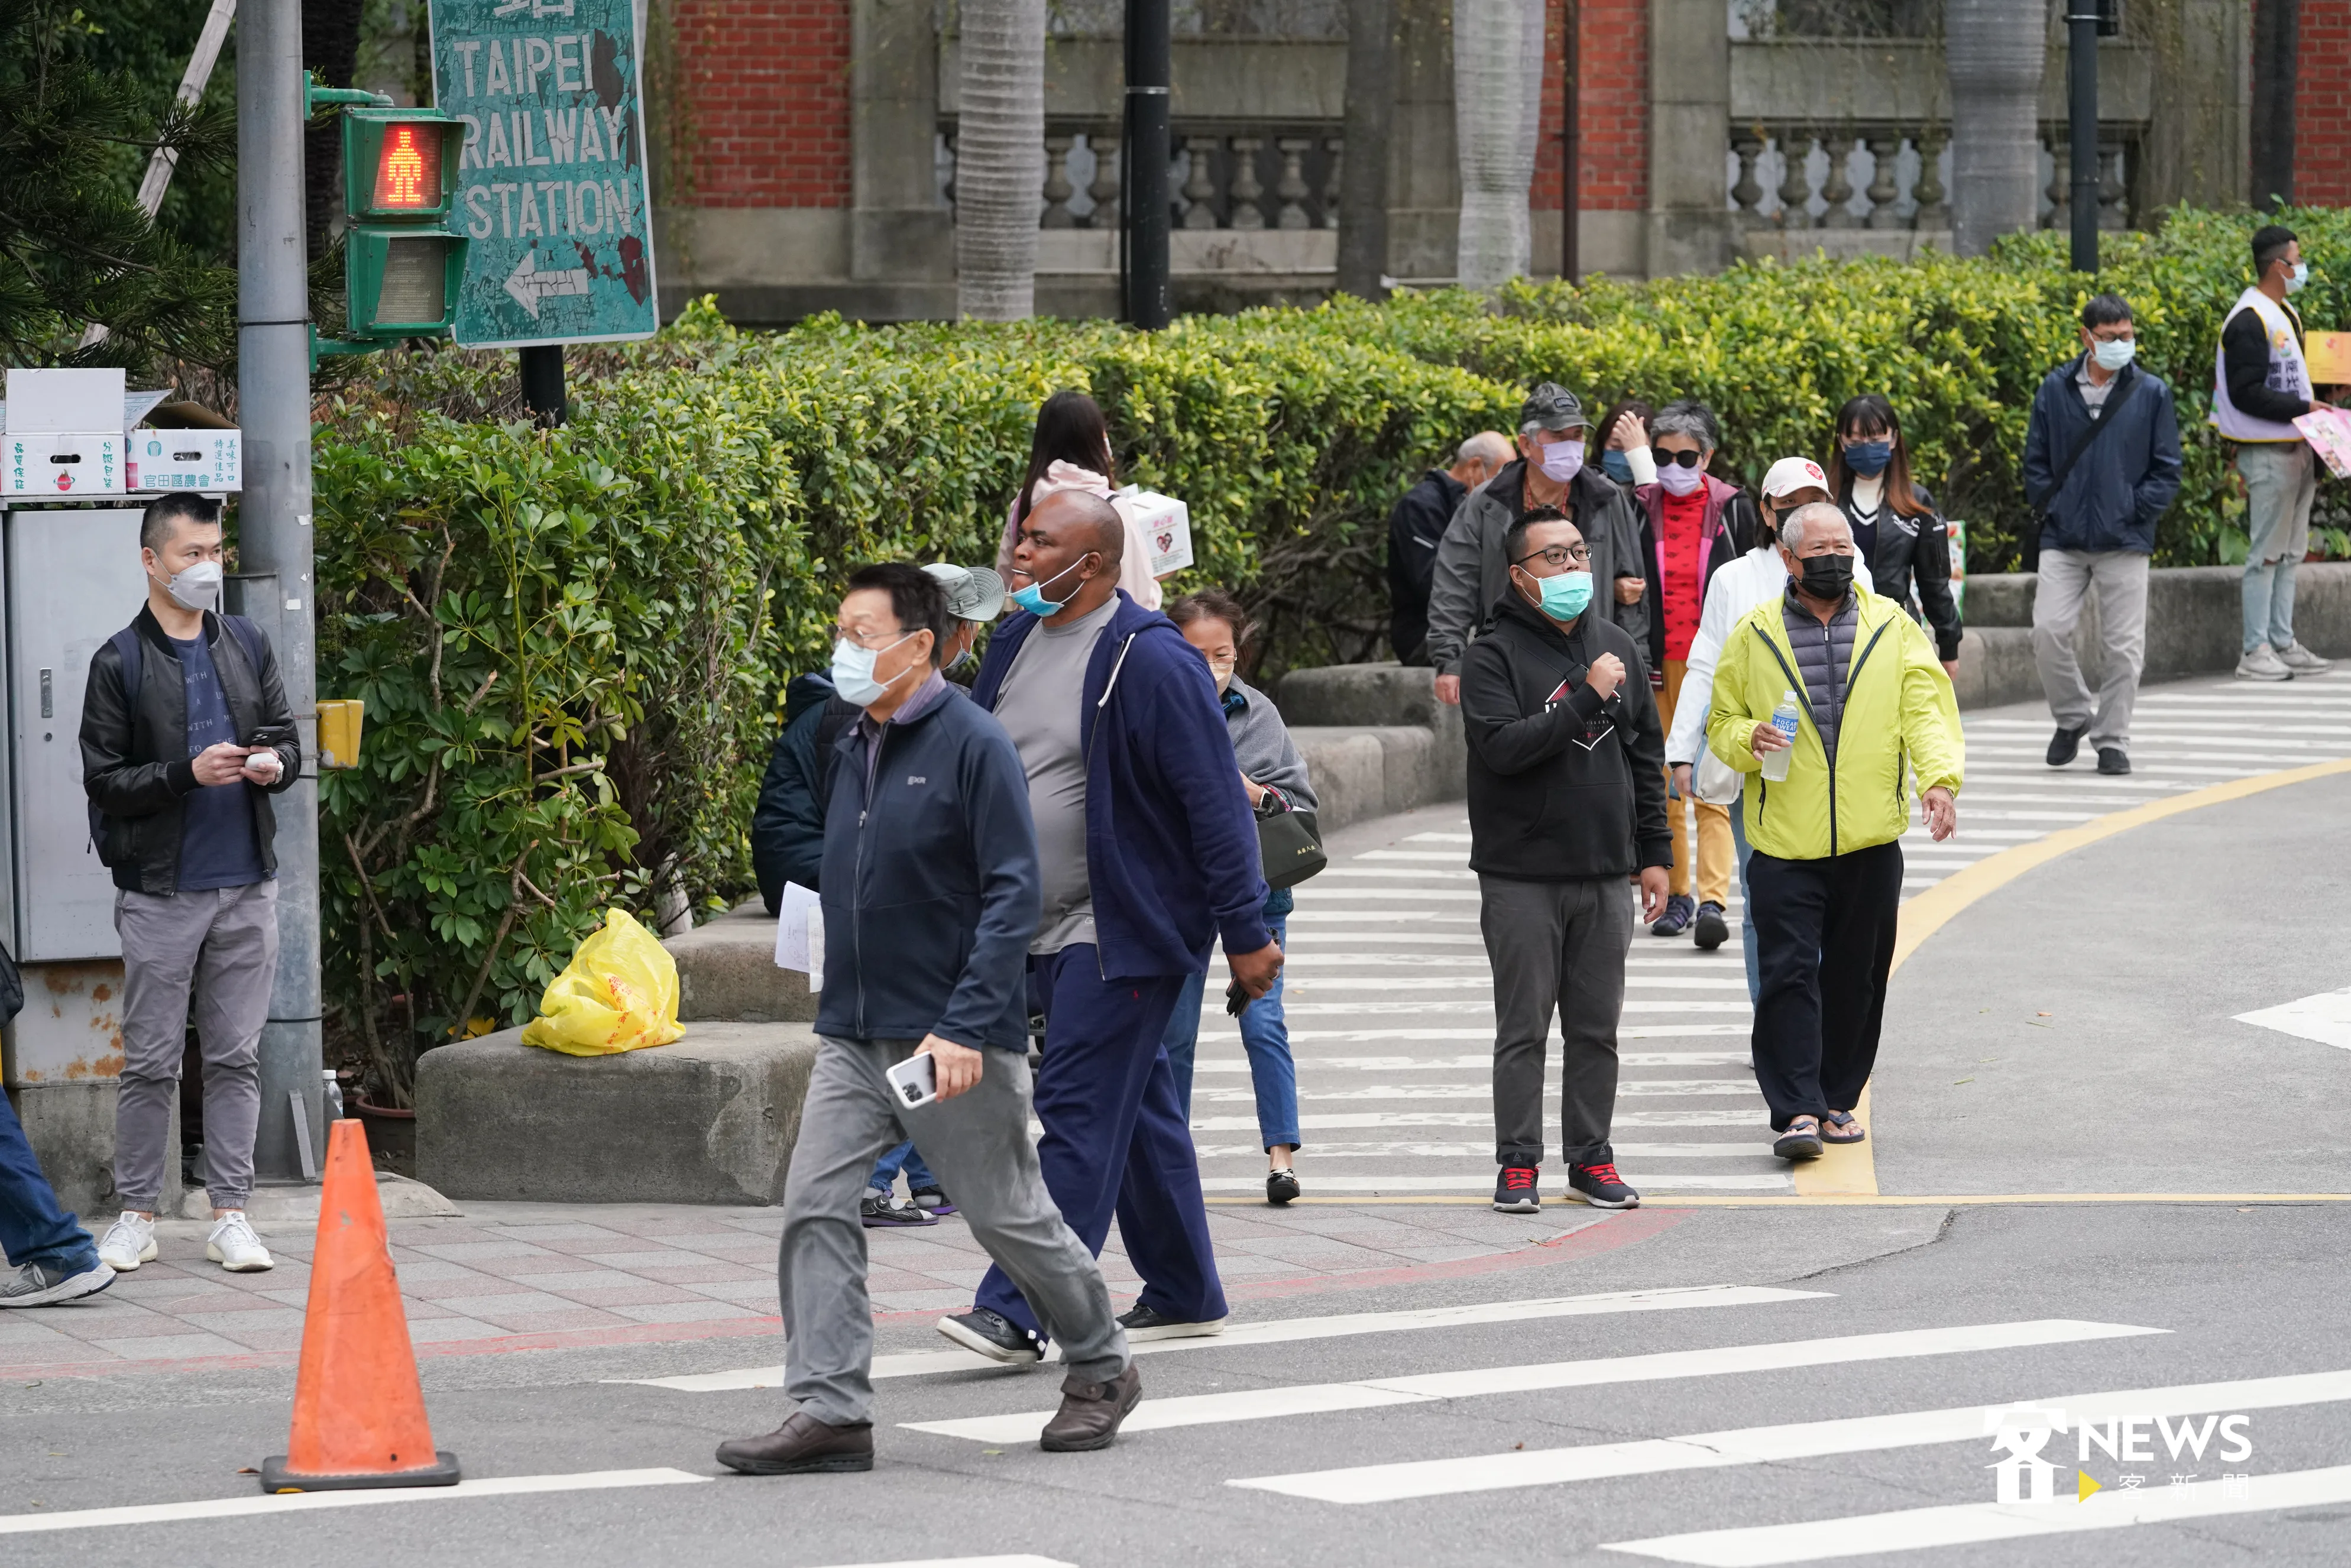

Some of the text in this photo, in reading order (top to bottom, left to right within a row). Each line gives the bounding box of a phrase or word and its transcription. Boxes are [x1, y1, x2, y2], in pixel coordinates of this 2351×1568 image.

[454, 34, 592, 97] TAIPEI
[456, 105, 623, 170] RAILWAY
[466, 179, 632, 239] STATION
[144, 474, 210, 487] 官田區農會
[214, 439, 224, 482] 特選佳品
[226, 439, 237, 481] 美味可口
[185, 671, 207, 684] WITH
[188, 719, 213, 731] WITH
[188, 745, 202, 753] TO
